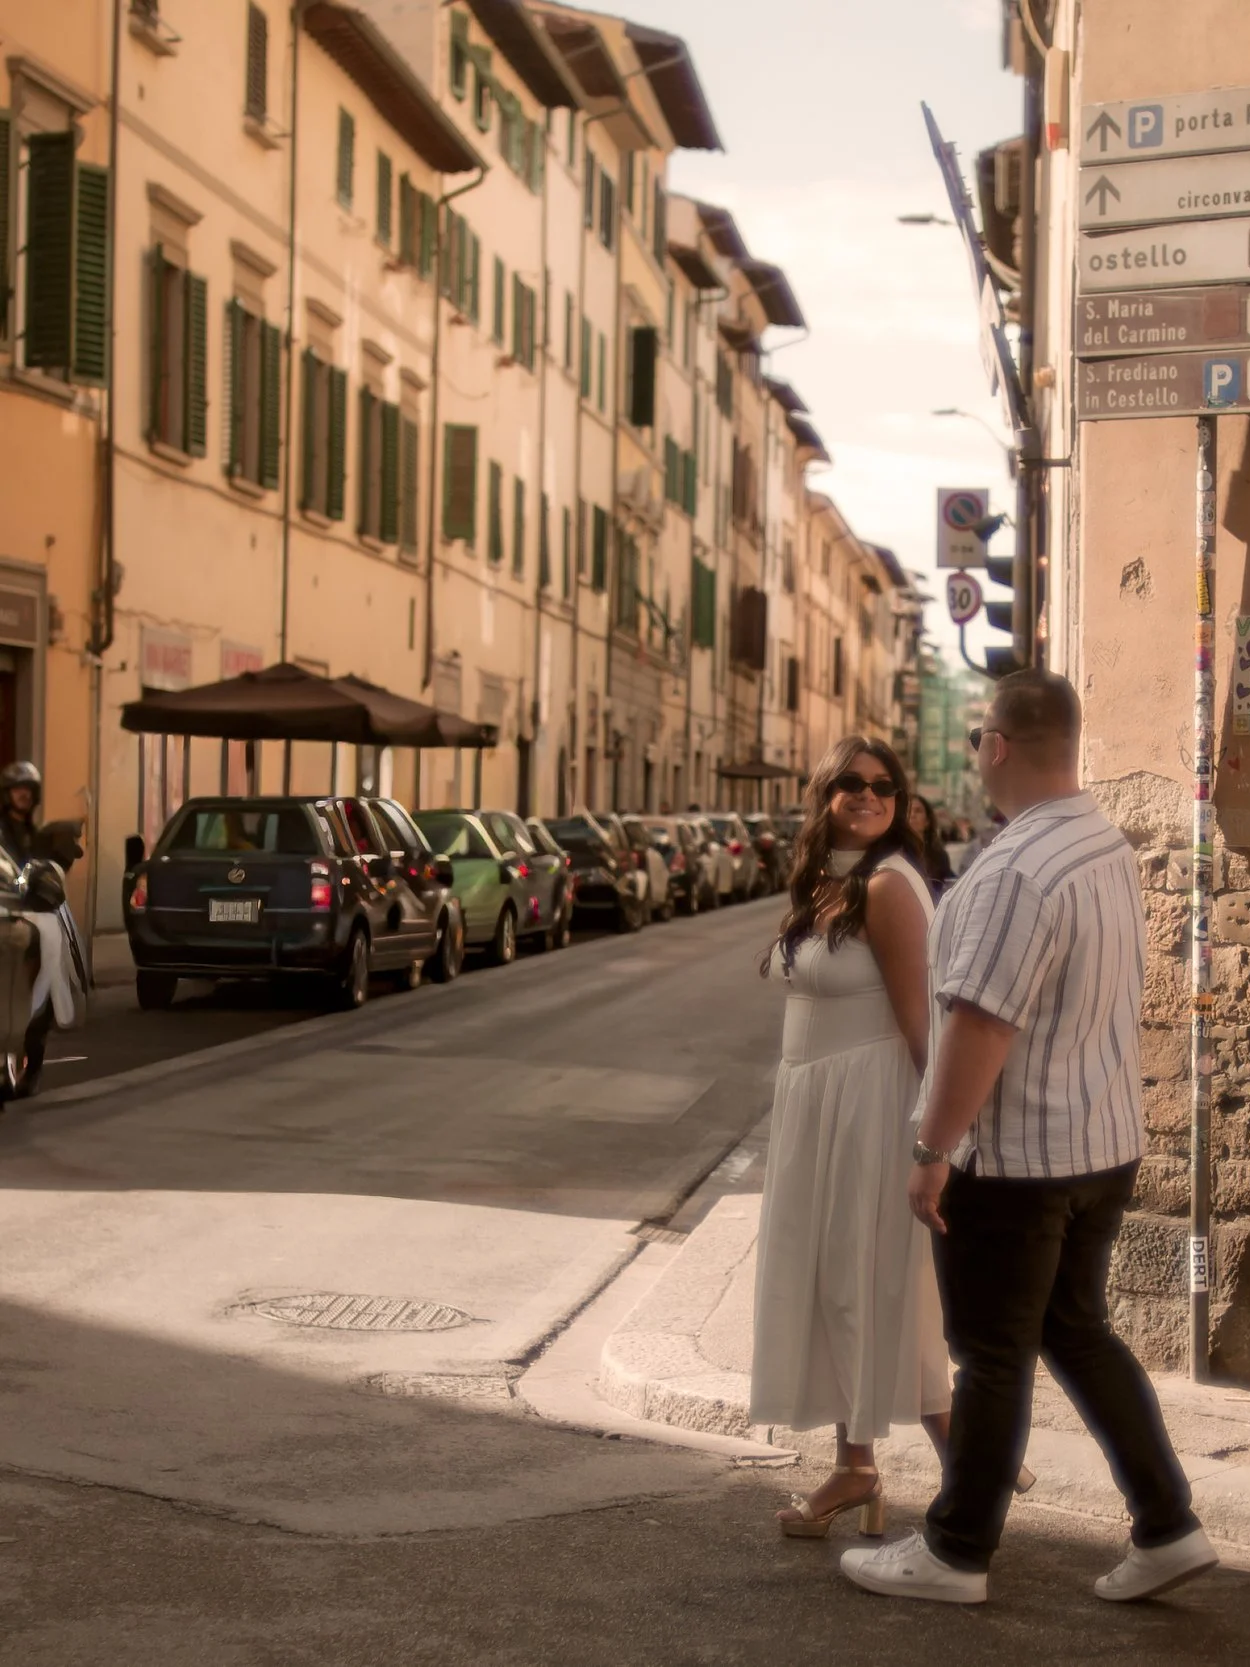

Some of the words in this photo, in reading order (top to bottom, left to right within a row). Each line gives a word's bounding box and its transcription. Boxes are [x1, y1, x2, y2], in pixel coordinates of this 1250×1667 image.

[1175, 109, 1233, 138] porta
[1089, 244, 1187, 272] ostello
[1086, 300, 1101, 319] S.
[1107, 298, 1154, 318] Maria
[1083, 325, 1109, 346] del
[1118, 323, 1187, 344] Carmine
[1086, 365, 1101, 384] S.
[1107, 361, 1178, 382] Frediano
[1085, 391, 1100, 409] in
[1107, 387, 1178, 409] Cestello
[1193, 1241, 1207, 1287] DERT
